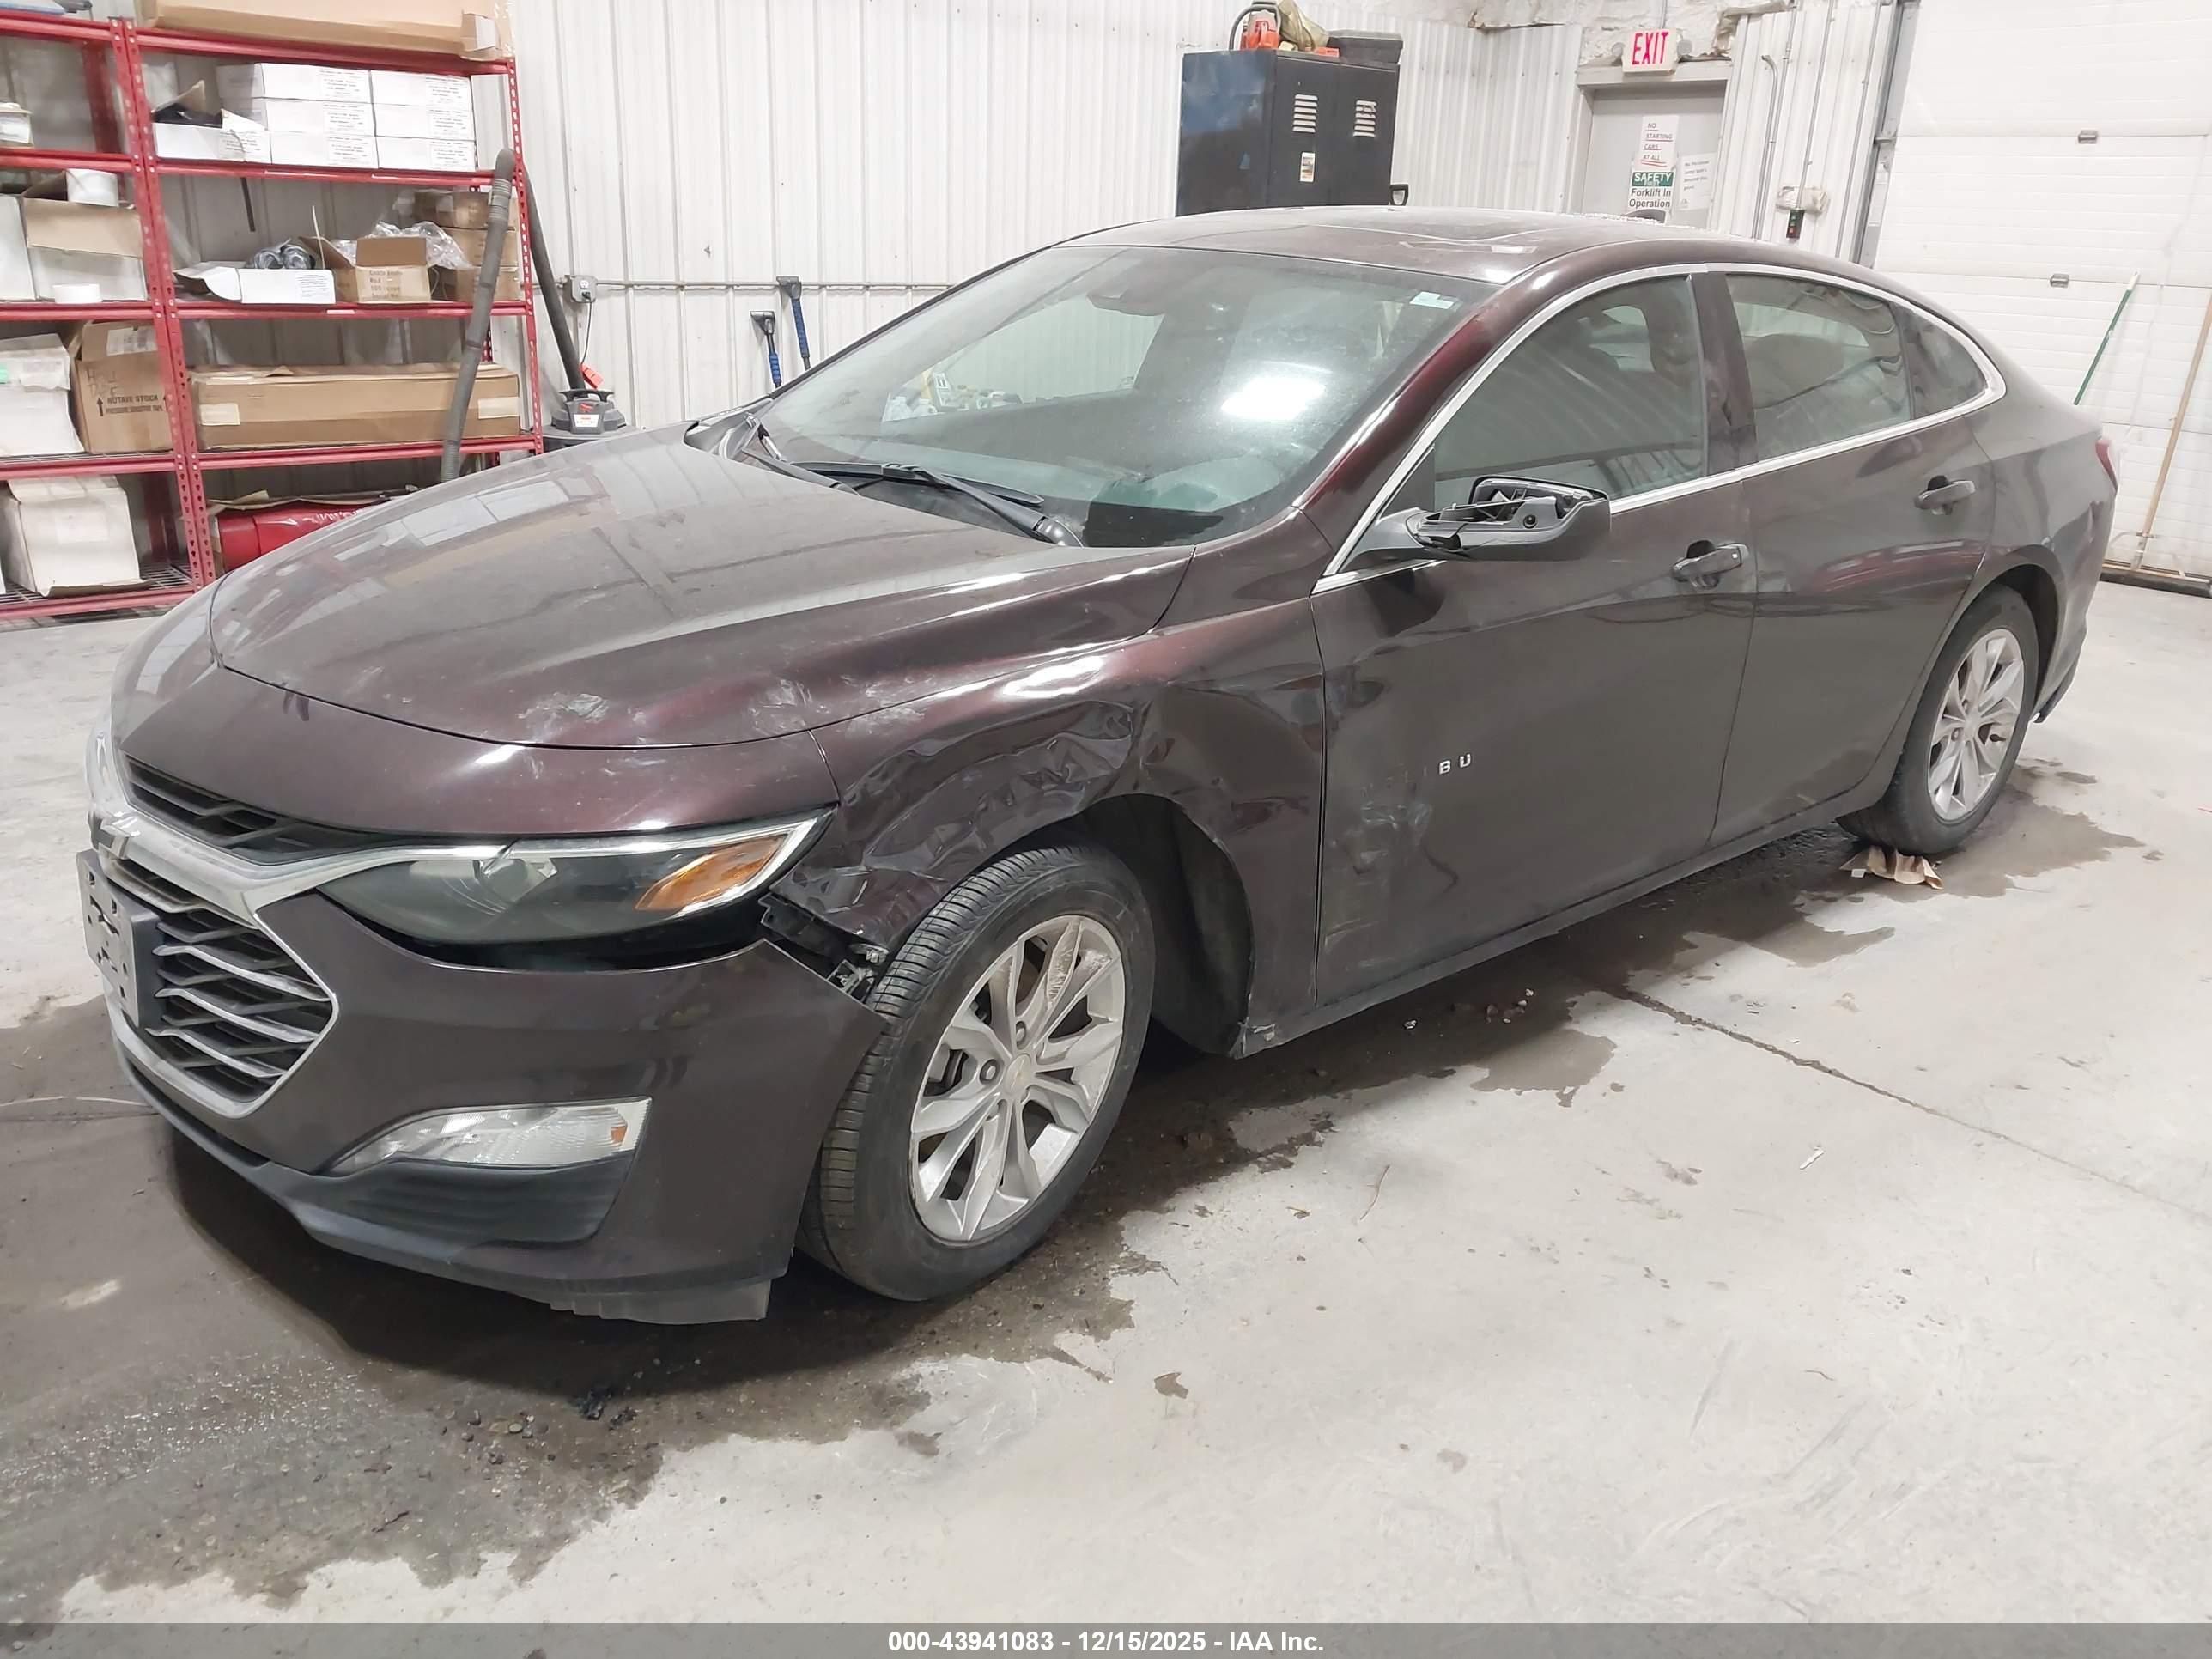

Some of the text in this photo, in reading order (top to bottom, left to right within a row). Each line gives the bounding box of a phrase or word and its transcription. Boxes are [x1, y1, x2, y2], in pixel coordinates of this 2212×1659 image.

[1632, 32, 1669, 64] EXIT
[1633, 173, 1672, 182] SAFETY
[1631, 188, 1671, 197] Forklift In
[1629, 198, 1671, 209] Operation
